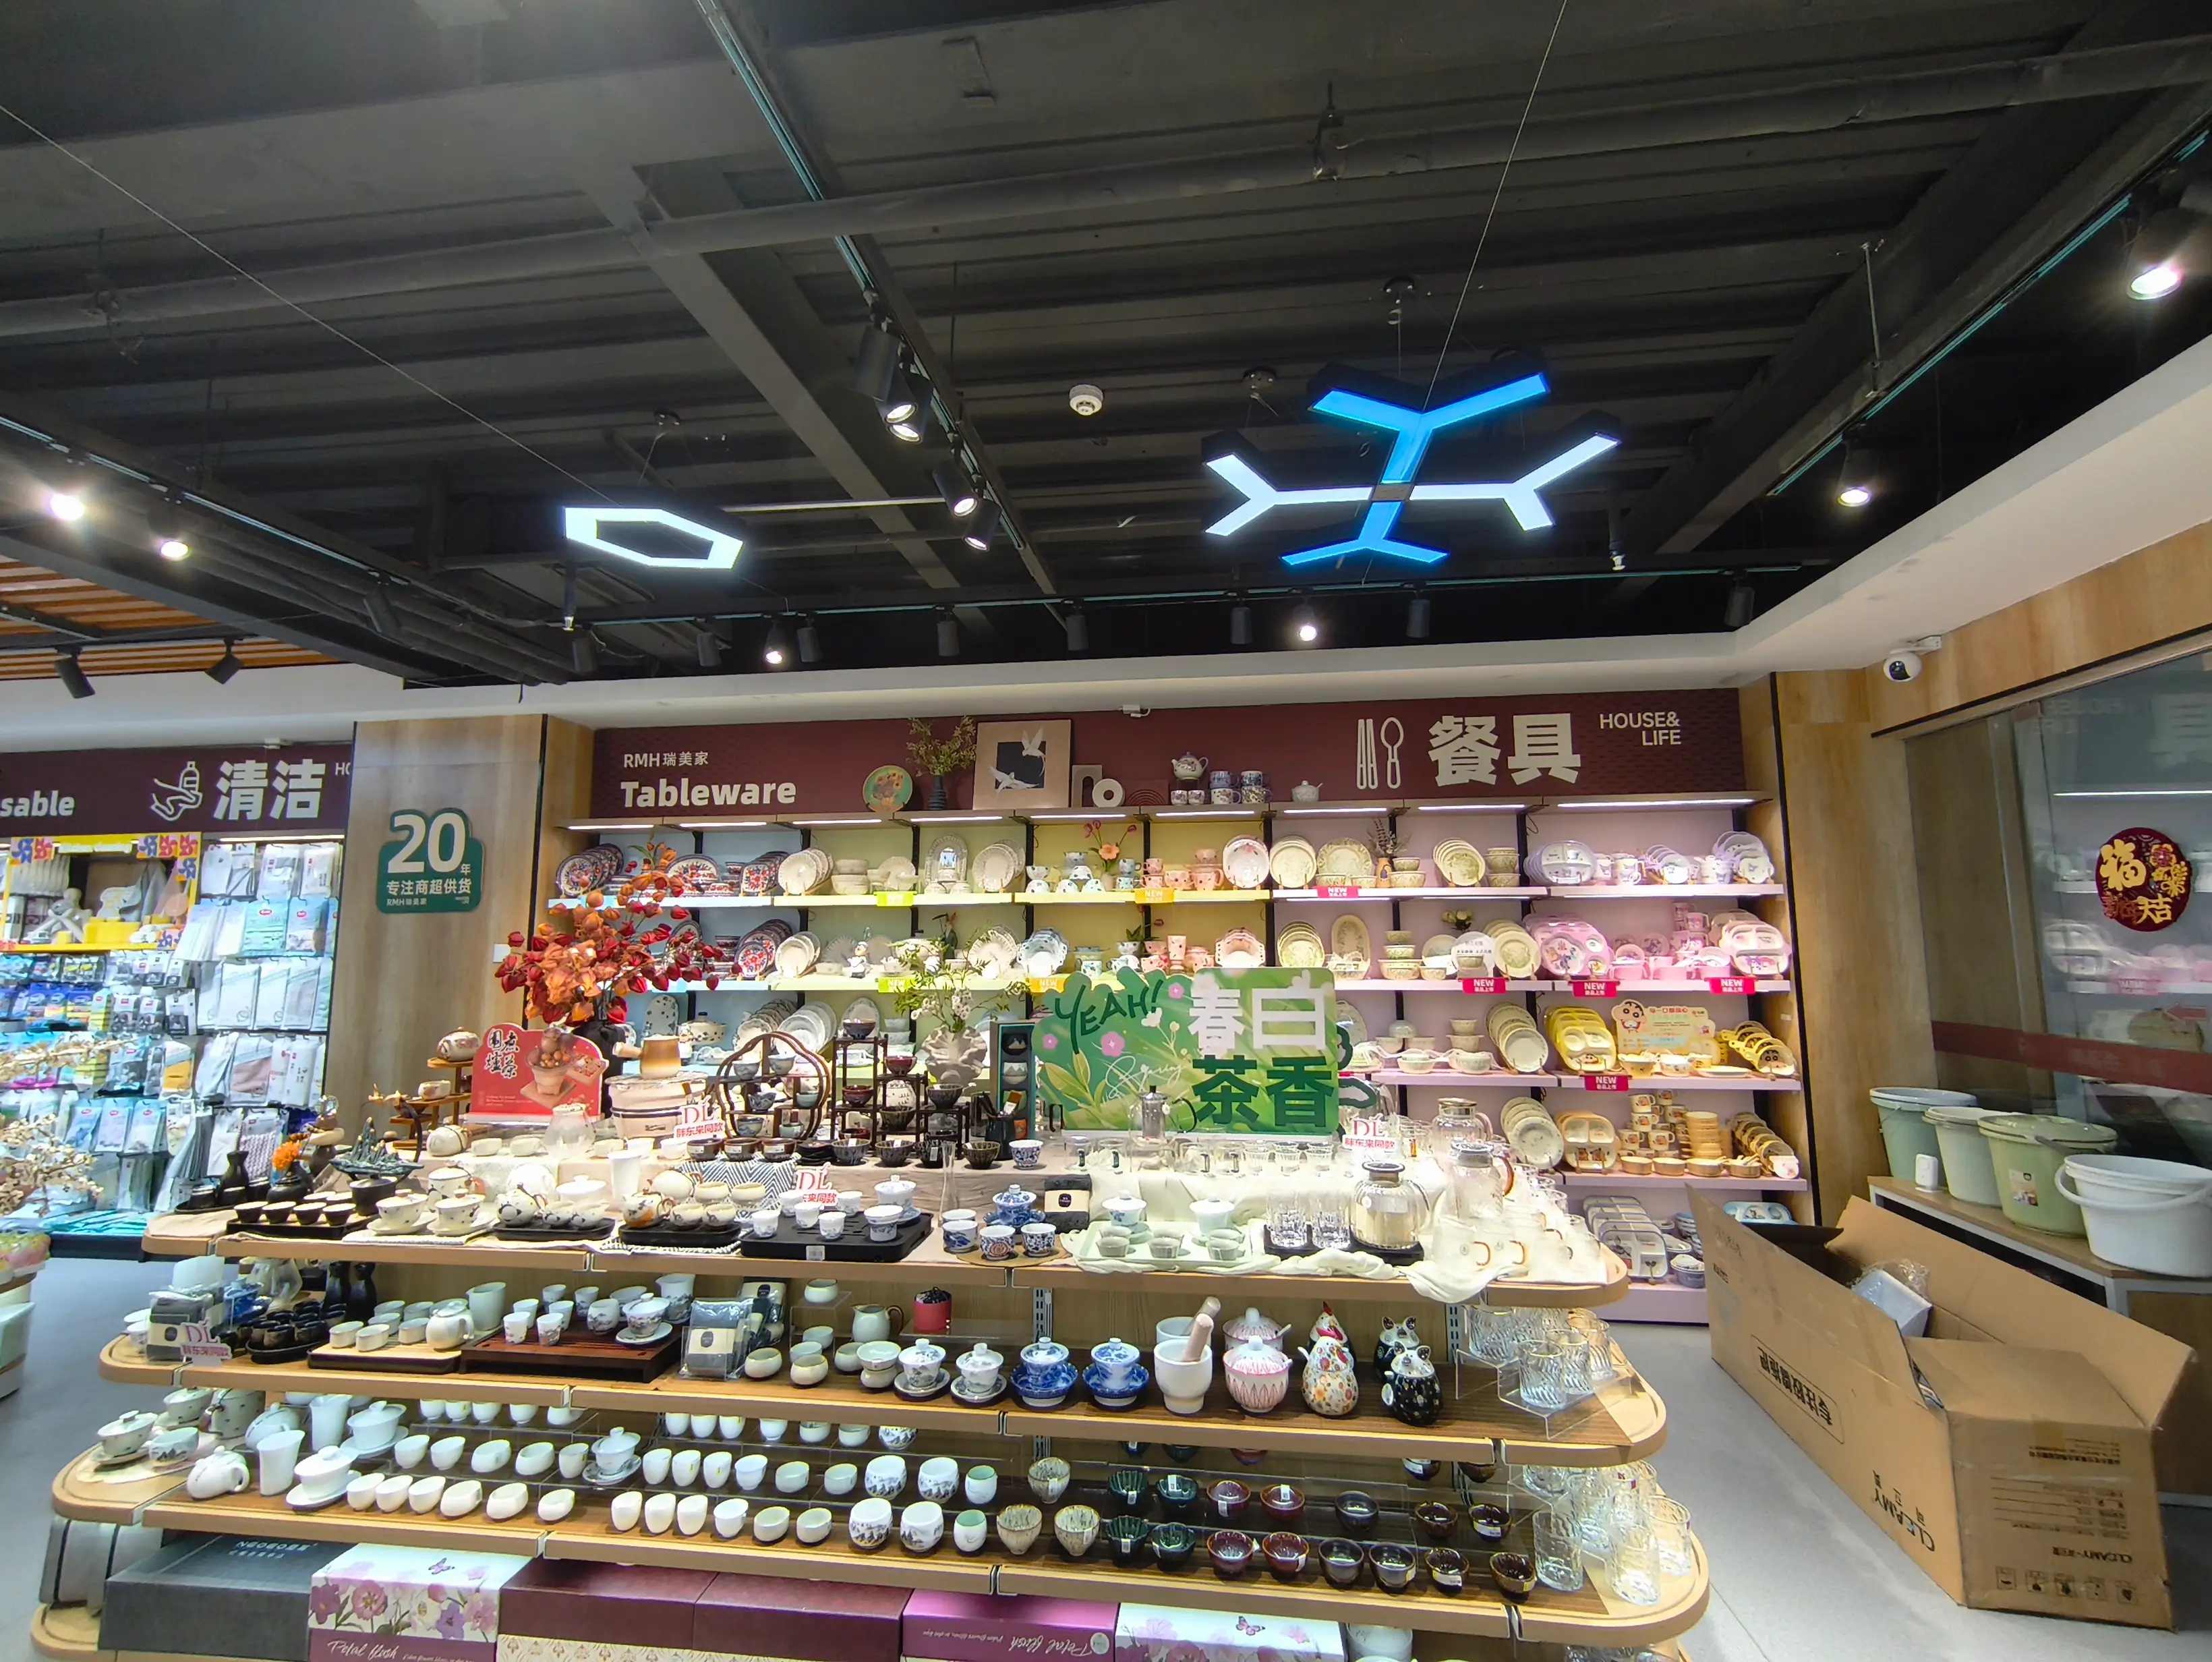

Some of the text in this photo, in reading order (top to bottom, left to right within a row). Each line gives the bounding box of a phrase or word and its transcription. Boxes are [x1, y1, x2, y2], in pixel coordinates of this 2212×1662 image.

[1600, 711, 1680, 729] HOUSE&
[1641, 729, 1681, 746] LIFE
[1428, 713, 1581, 787] 餐具
[213, 759, 326, 821] 清洁
[620, 778, 796, 807] Tableware
[386, 878, 471, 896] 专注商超供货
[1040, 978, 1057, 987] NEW
[1474, 979, 1494, 987] NEW
[1584, 982, 1606, 990] NEW
[1721, 979, 1743, 987] NEW
[1054, 978, 1165, 1054] YEAH!
[1192, 1054, 1335, 1128] 茶香
